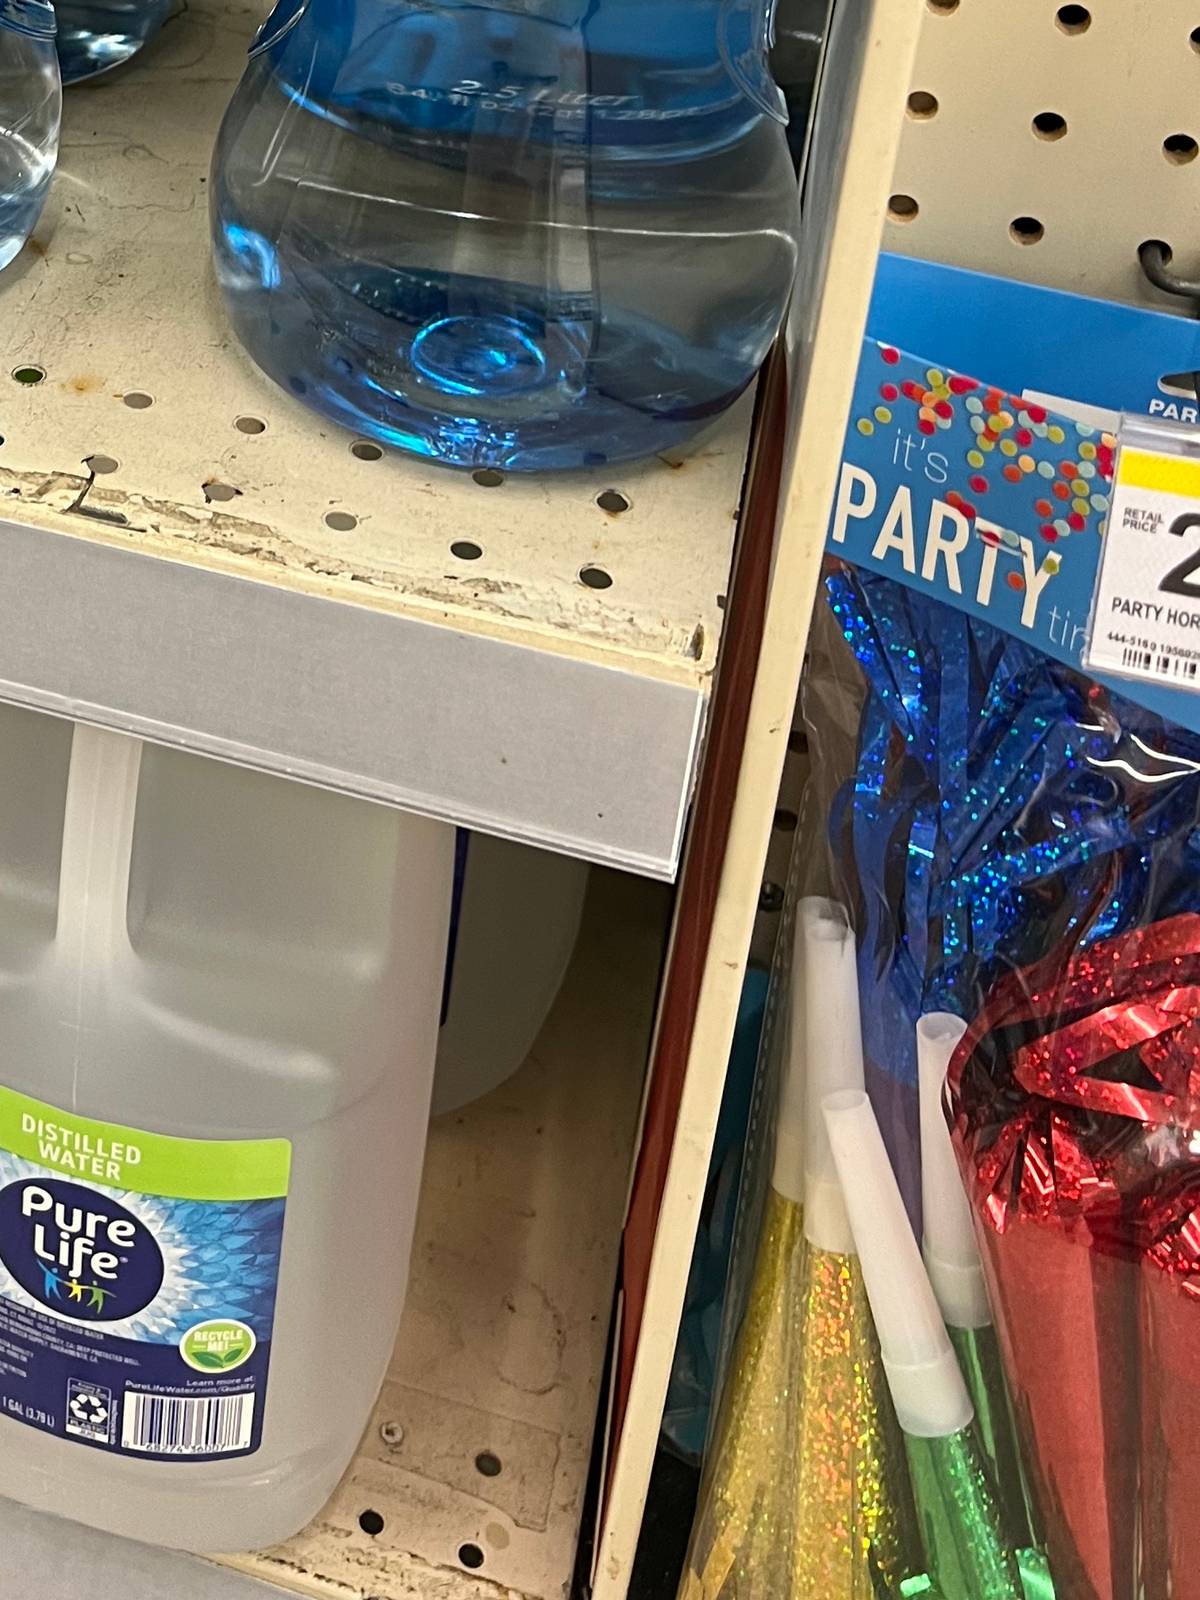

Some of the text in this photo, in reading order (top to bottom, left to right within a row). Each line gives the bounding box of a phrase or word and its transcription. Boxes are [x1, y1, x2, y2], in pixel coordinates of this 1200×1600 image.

[892, 429, 949, 483] it's
[1122, 518, 1158, 534] PRICE
[1124, 507, 1164, 524] RETAIL
[832, 462, 1062, 629] PARTY
[1112, 597, 1163, 622] PARTY
[22, 1112, 141, 1164] DISTILLED
[39, 1139, 120, 1181] WATER
[21, 1185, 136, 1248] Pure
[33, 1224, 118, 1279] Life
[194, 1329, 243, 1341] RECYCLE
[207, 1340, 229, 1352] ME!
[8, 1399, 24, 1415] GAL
